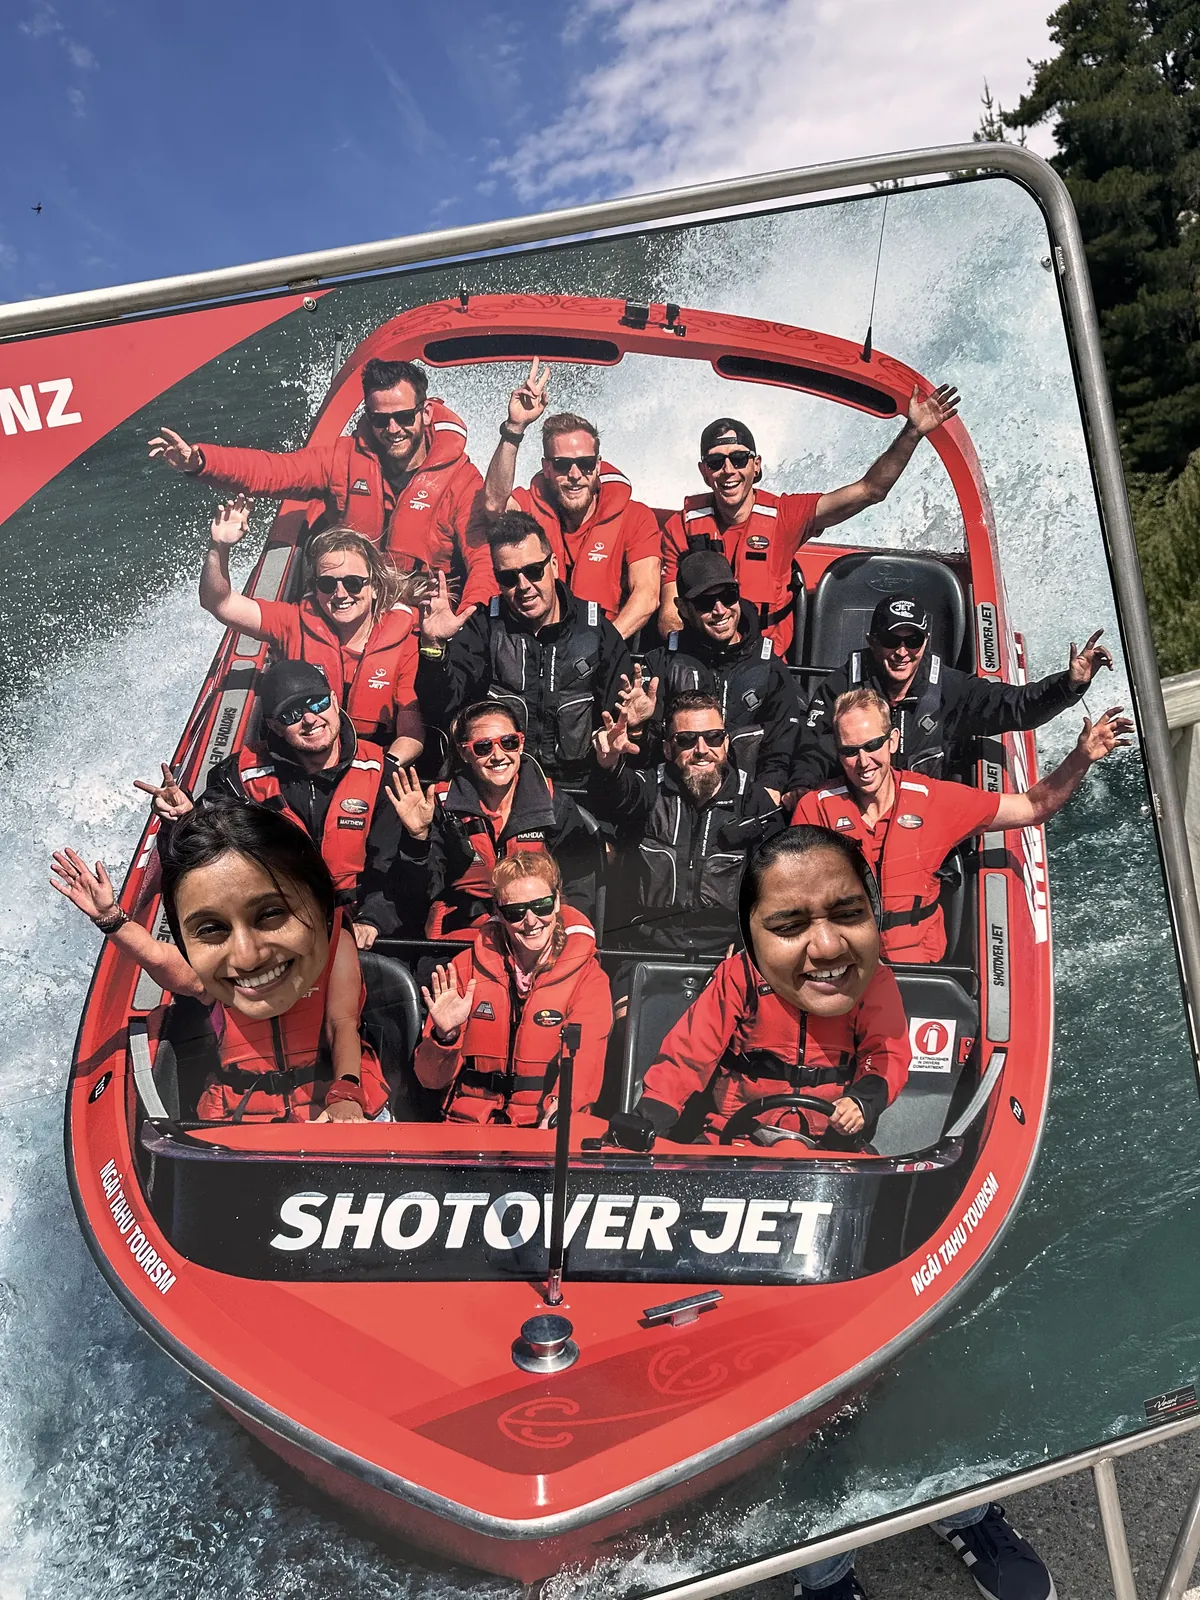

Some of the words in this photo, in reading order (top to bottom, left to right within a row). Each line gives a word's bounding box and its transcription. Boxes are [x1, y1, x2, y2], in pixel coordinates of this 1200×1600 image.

[0, 378, 83, 436] NZ
[981, 604, 993, 626] JET
[983, 626, 996, 669] SHOTOVER
[214, 707, 238, 747] SHOTOVER
[987, 763, 998, 782] JET
[991, 923, 1004, 944] JET
[992, 944, 1004, 987] SHOTOVER
[109, 1189, 136, 1235] TAHU
[125, 1224, 177, 1295] TOURISM
[269, 1191, 681, 1251] SHOTOVER
[690, 1198, 833, 1255] JET
[910, 1253, 943, 1296] NGĀI
[938, 1222, 968, 1265] TAHU
[962, 1171, 999, 1233] TOURISM
